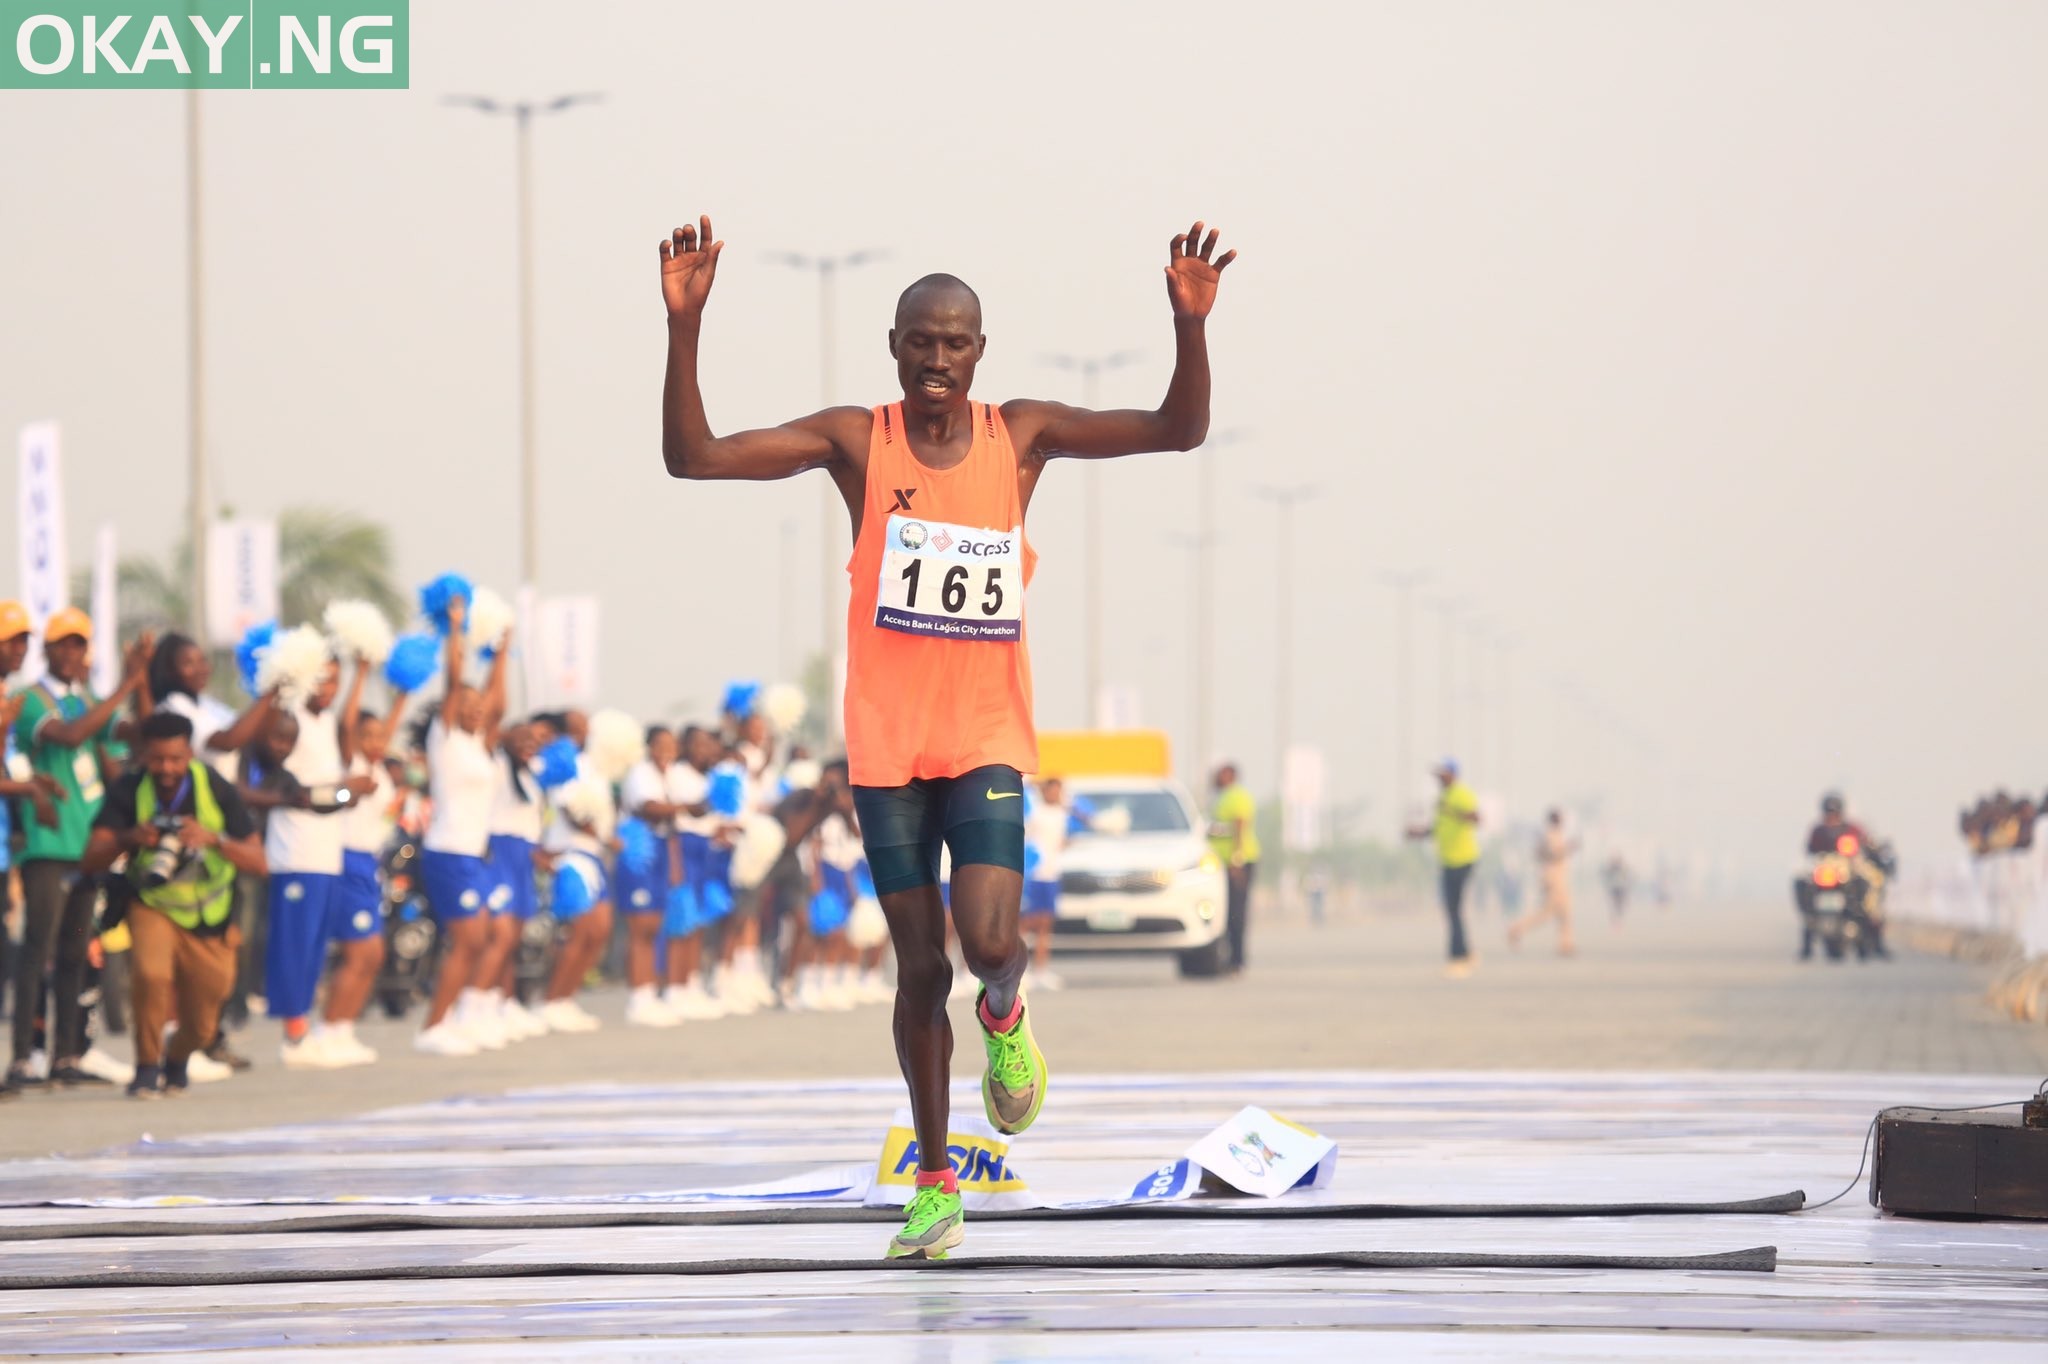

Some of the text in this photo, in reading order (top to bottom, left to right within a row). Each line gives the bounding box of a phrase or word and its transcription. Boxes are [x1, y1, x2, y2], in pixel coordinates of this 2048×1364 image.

[883, 614, 1016, 636] Access Bank Lagos City Marathon
